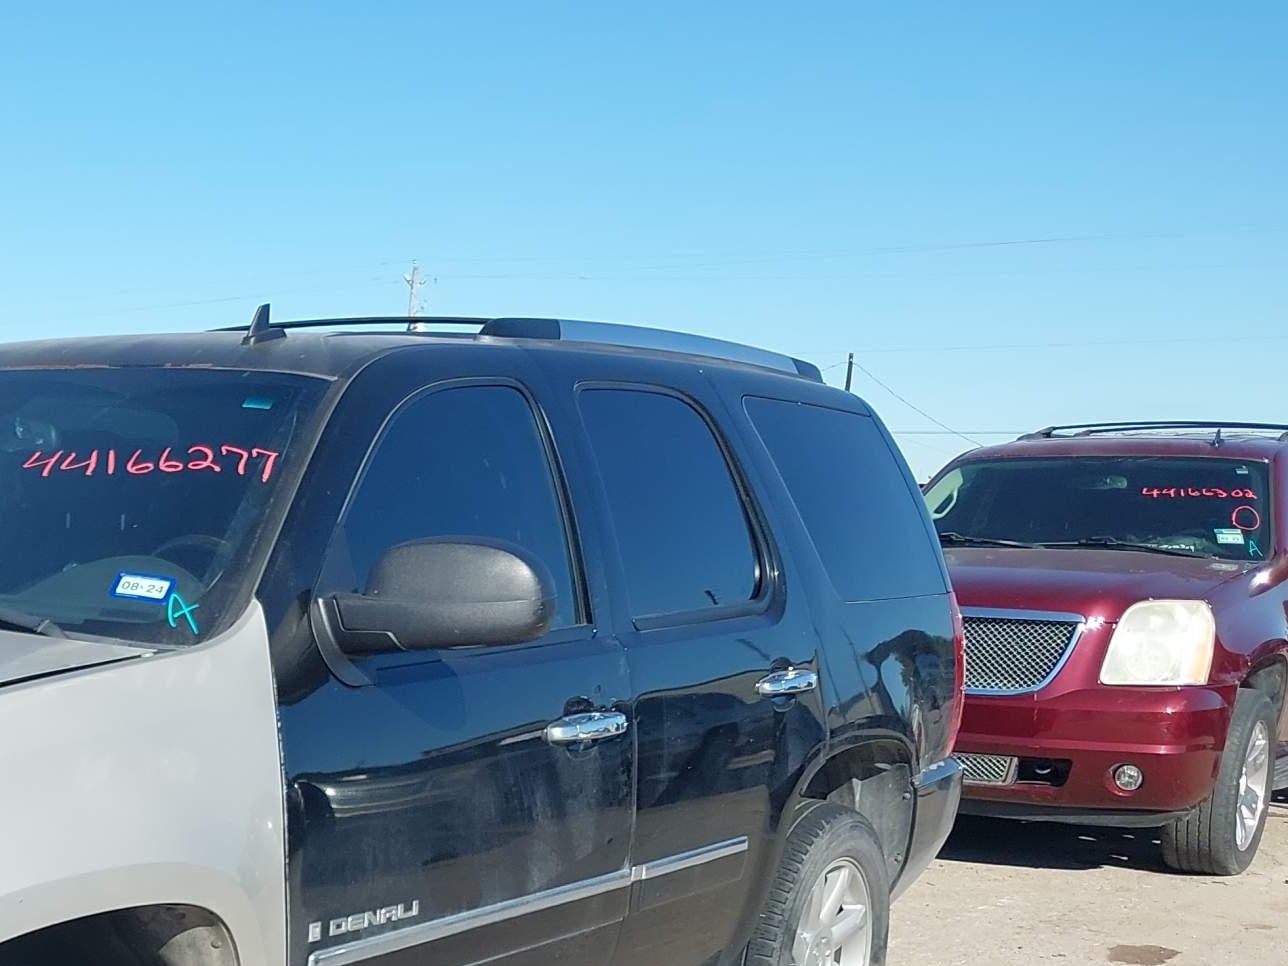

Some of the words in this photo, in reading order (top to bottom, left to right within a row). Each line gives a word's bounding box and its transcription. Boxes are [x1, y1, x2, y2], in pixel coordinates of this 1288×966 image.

[22, 446, 279, 482] 44166277
[1248, 539, 1264, 557] A
[167, 592, 200, 634] A
[329, 900, 419, 936] DENALI
